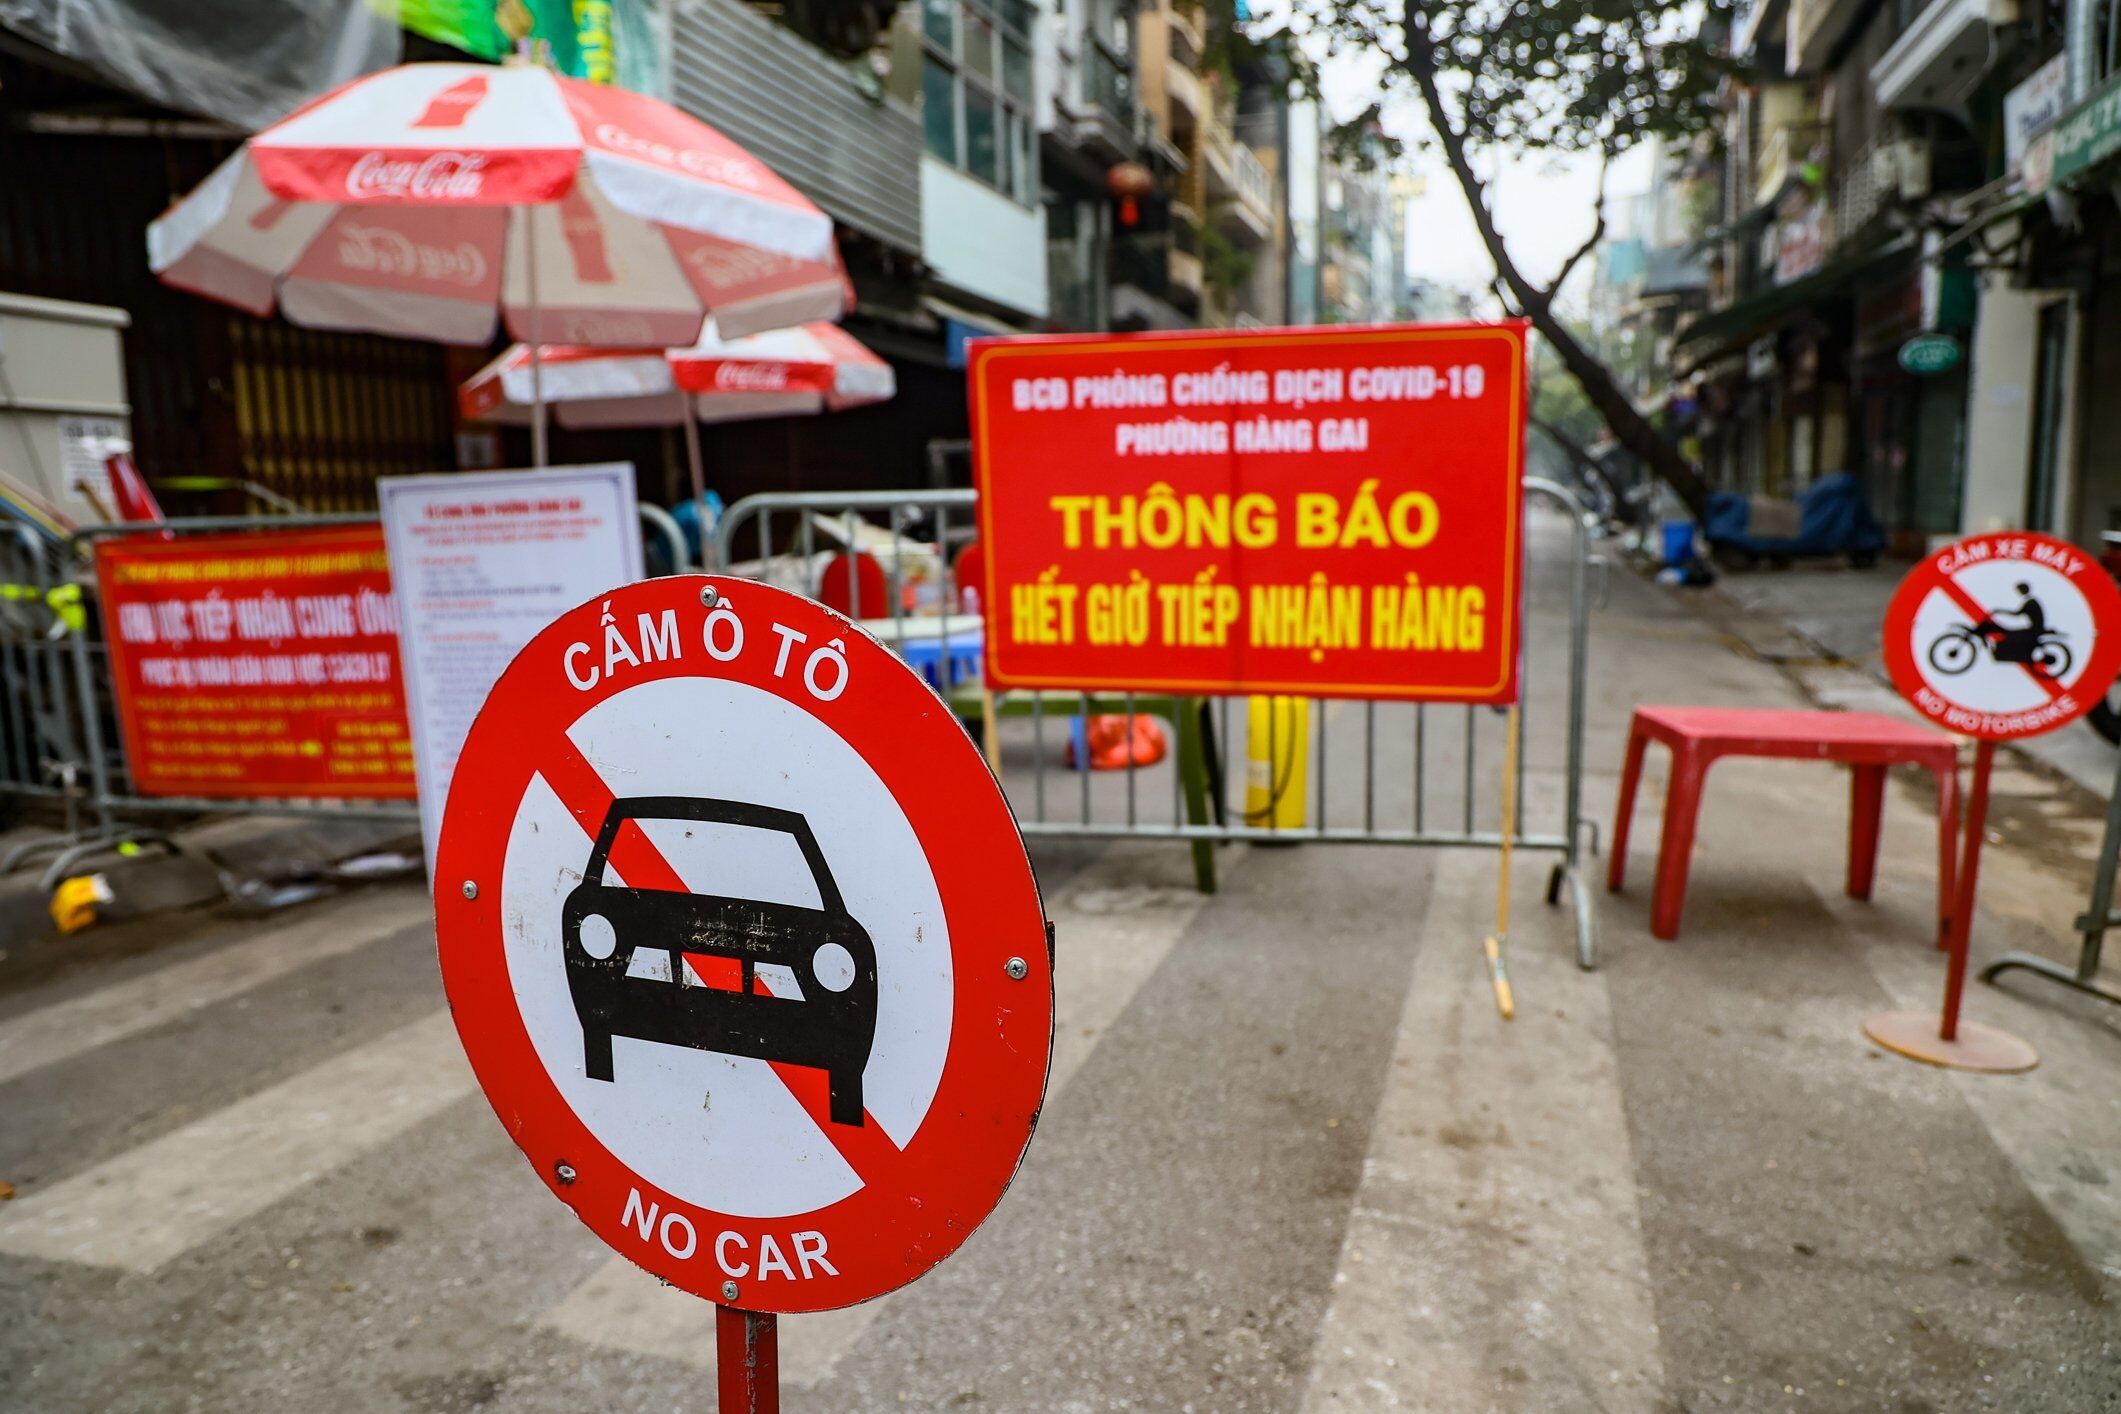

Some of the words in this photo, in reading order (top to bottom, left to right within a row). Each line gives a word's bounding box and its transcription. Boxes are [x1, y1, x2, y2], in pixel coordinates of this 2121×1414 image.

[1072, 367, 1167, 409] PHÒNG
[1171, 361, 1269, 406] CHỐNG
[1274, 368, 1344, 410] DỊCH
[1349, 364, 1485, 402] COVID-19
[1115, 414, 1229, 457] PHƯỜNG
[1233, 413, 1313, 454] HÀNG
[1318, 417, 1370, 452] GAI
[1050, 481, 1278, 549] THÔNG
[1296, 478, 1440, 549] BÁO
[1994, 538, 2028, 558] XE
[1011, 564, 1079, 646] HẾT
[1086, 568, 1150, 647] GIỜ
[1157, 564, 1240, 647] TIẾP
[1250, 570, 1363, 664] NHẬN
[1371, 570, 1486, 652] HÀNG
[563, 600, 682, 691] CẤM
[703, 597, 744, 661] Ô
[771, 622, 849, 701] TÔ
[1913, 687, 1946, 716] NO
[1943, 694, 2079, 735] MOTORBIKE
[620, 1187, 697, 1260] NO
[714, 1230, 840, 1281] CAR
